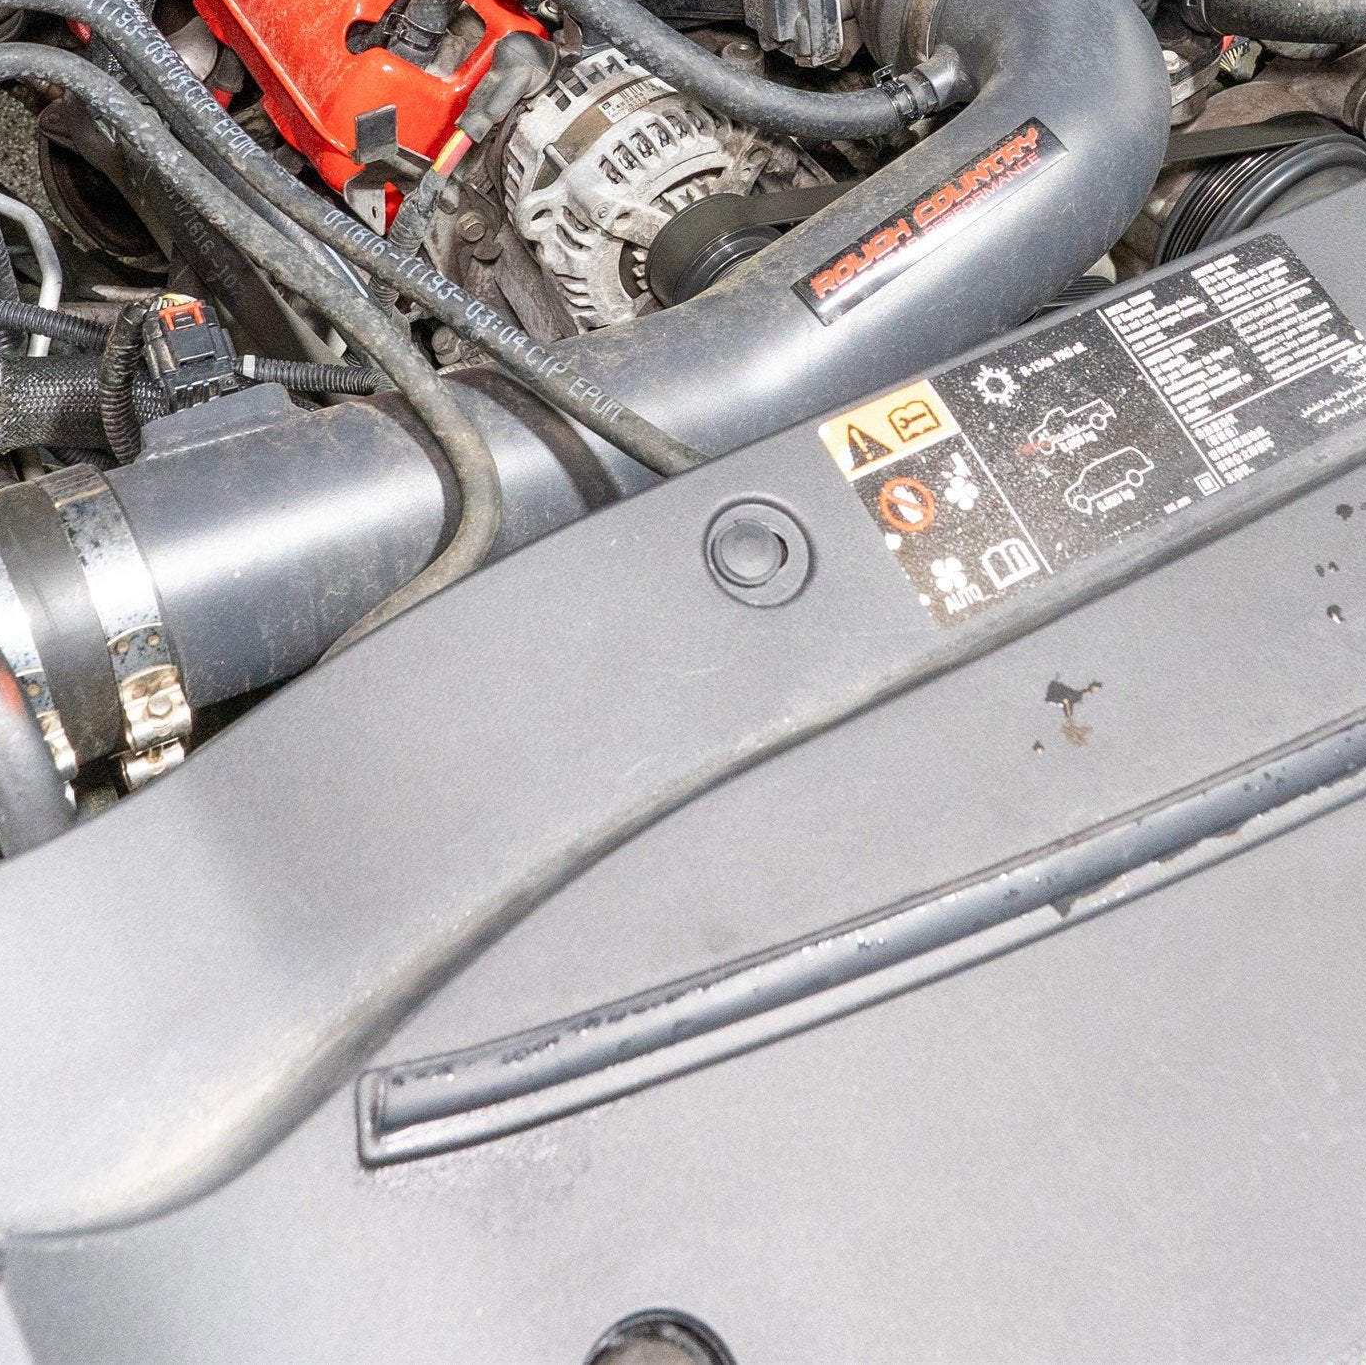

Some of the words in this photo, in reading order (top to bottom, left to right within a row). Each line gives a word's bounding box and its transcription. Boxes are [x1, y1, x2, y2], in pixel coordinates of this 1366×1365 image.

[810, 219, 912, 299] ROUGH
[913, 126, 1040, 228] COUNTRY
[923, 151, 1041, 237] PERFORMANCE
[1018, 355, 1054, 378] R-134a
[1054, 346, 1074, 362] PAG
[565, 373, 625, 425] EPDM
[943, 582, 984, 614] AUTO
